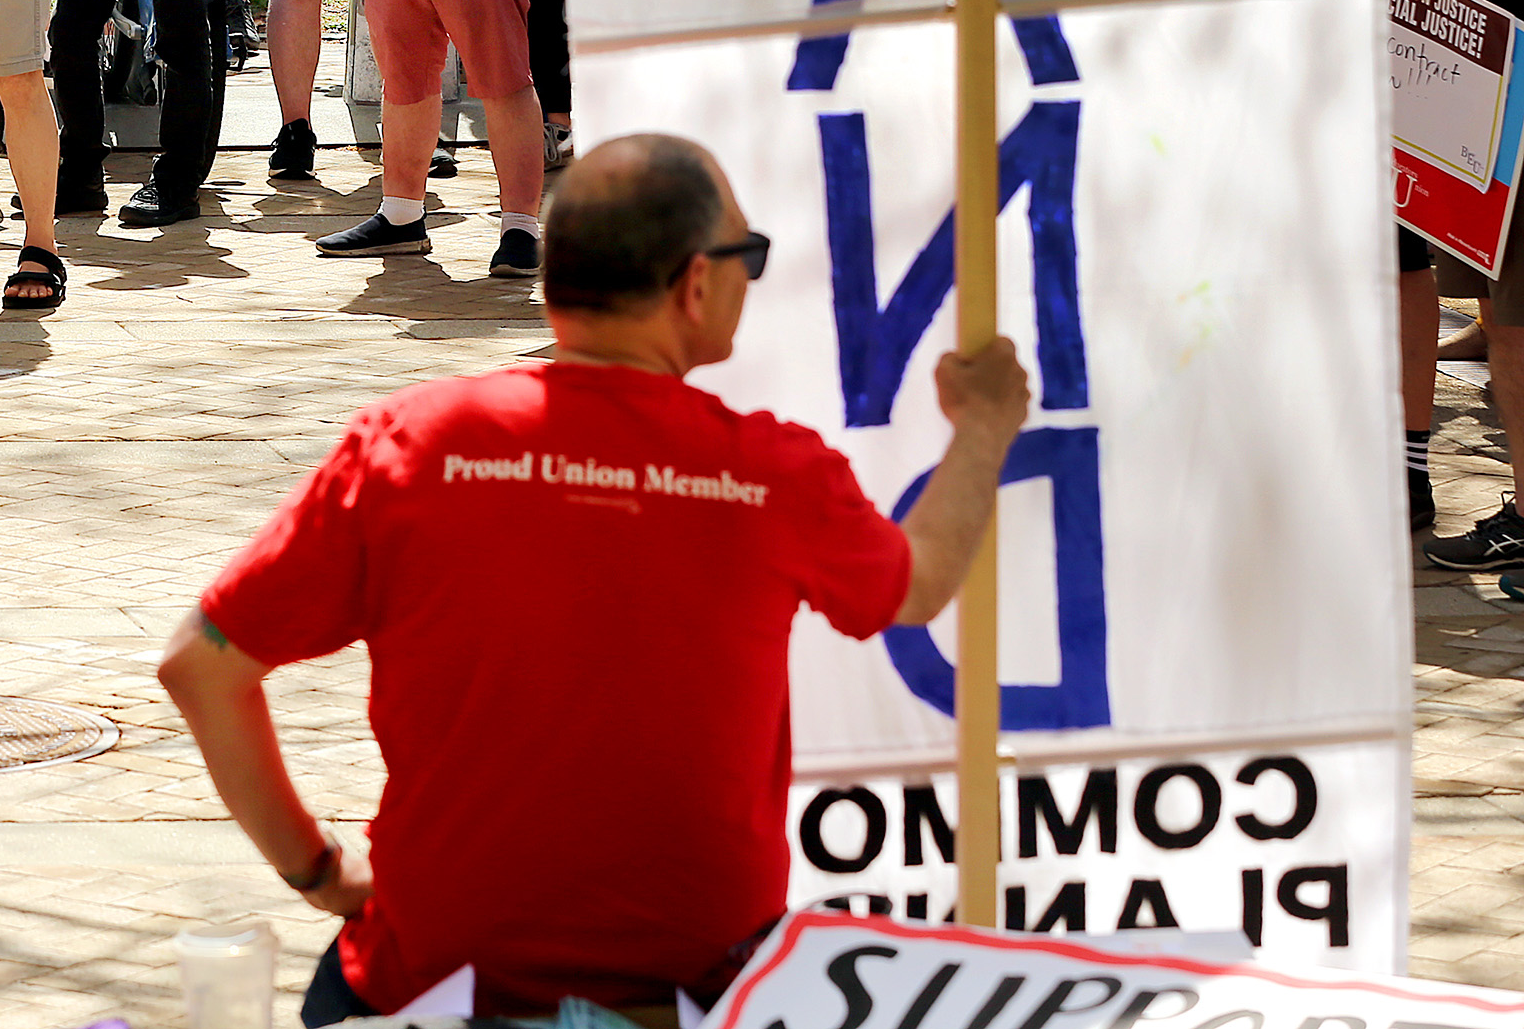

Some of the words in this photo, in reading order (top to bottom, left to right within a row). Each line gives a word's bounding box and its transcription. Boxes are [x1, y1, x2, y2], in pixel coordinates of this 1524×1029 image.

[1421, 9, 1484, 59] JUSTICE!
[443, 451, 534, 483] Proud
[541, 453, 636, 491] Union
[644, 463, 770, 507] Member
